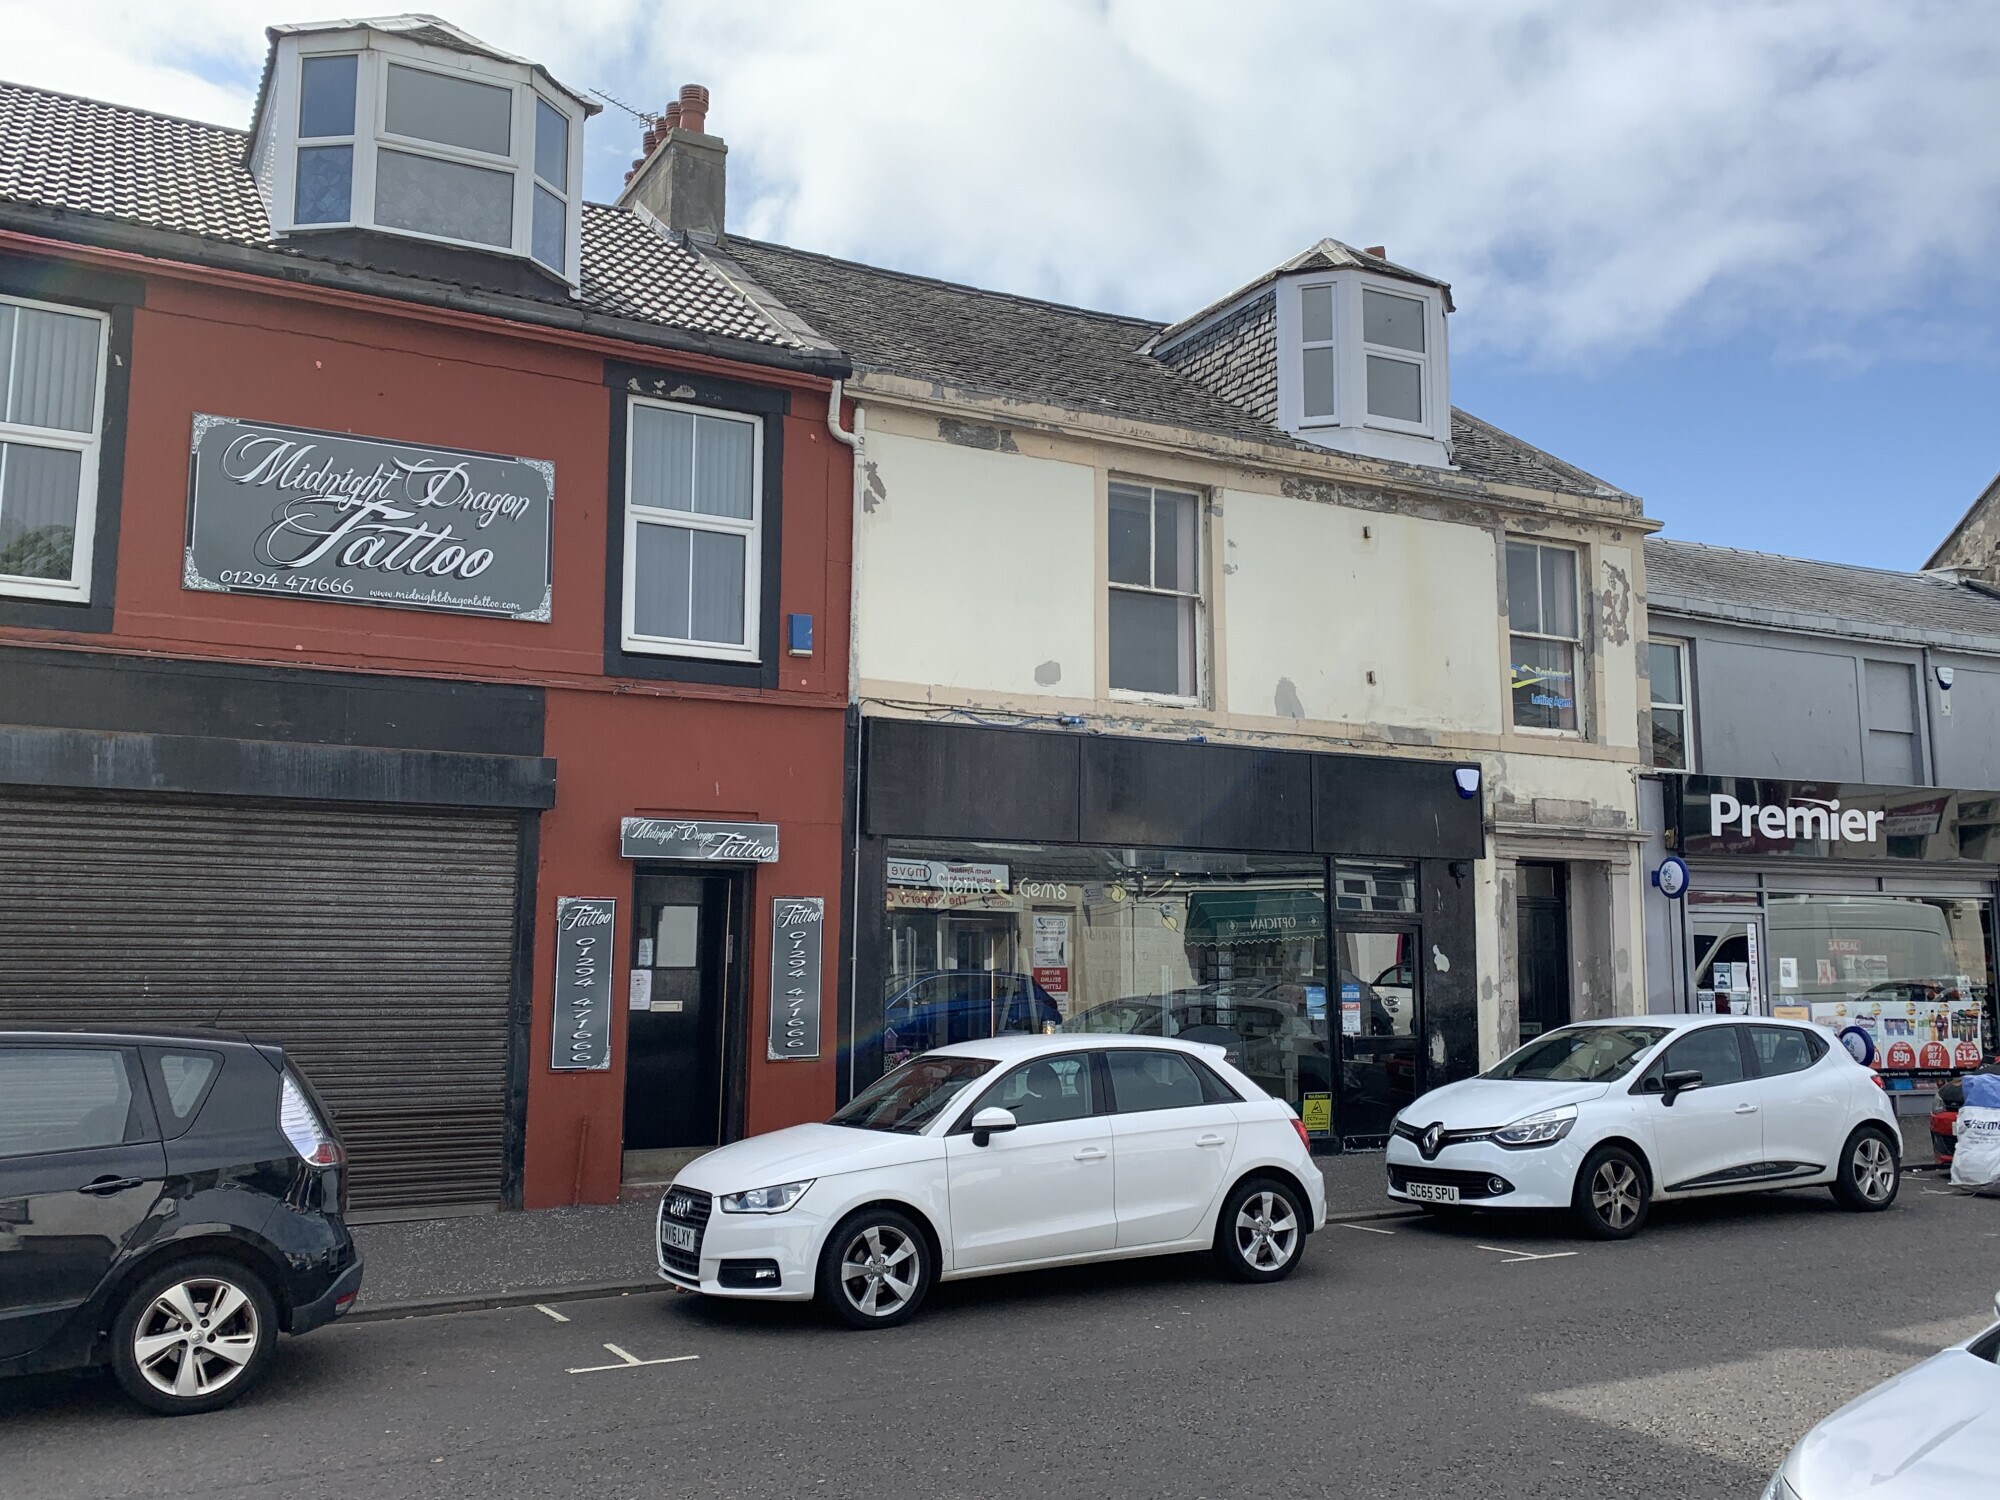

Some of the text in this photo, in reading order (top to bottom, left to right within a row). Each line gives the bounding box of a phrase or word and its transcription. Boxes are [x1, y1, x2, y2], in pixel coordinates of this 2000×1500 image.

[222, 433, 530, 528] Midnight Dragon
[266, 494, 495, 579] Tattoo
[219, 569, 354, 594] 01294 471666
[369, 589, 522, 610] www.midnightdragontattoo.com
[1531, 692, 1573, 709] Letting Agent
[1710, 793, 1884, 844] Premier
[628, 821, 715, 847] Midnight Dragon
[700, 832, 774, 859] Tattoo
[933, 872, 1067, 908] Stems Gems
[561, 903, 611, 930] Tattoo
[777, 903, 820, 927] Tattoo
[573, 937, 596, 987] 01294
[787, 931, 807, 979] 01294
[571, 997, 594, 1061] 471666
[786, 987, 805, 1047] 471666
[1893, 1050, 1910, 1065] 99p
[1928, 1059, 1942, 1067] FREE
[1956, 1049, 1979, 1061] £1.25
[1410, 1183, 1455, 1201] SC65 SPU
[664, 1223, 691, 1248] NY16 LXY
